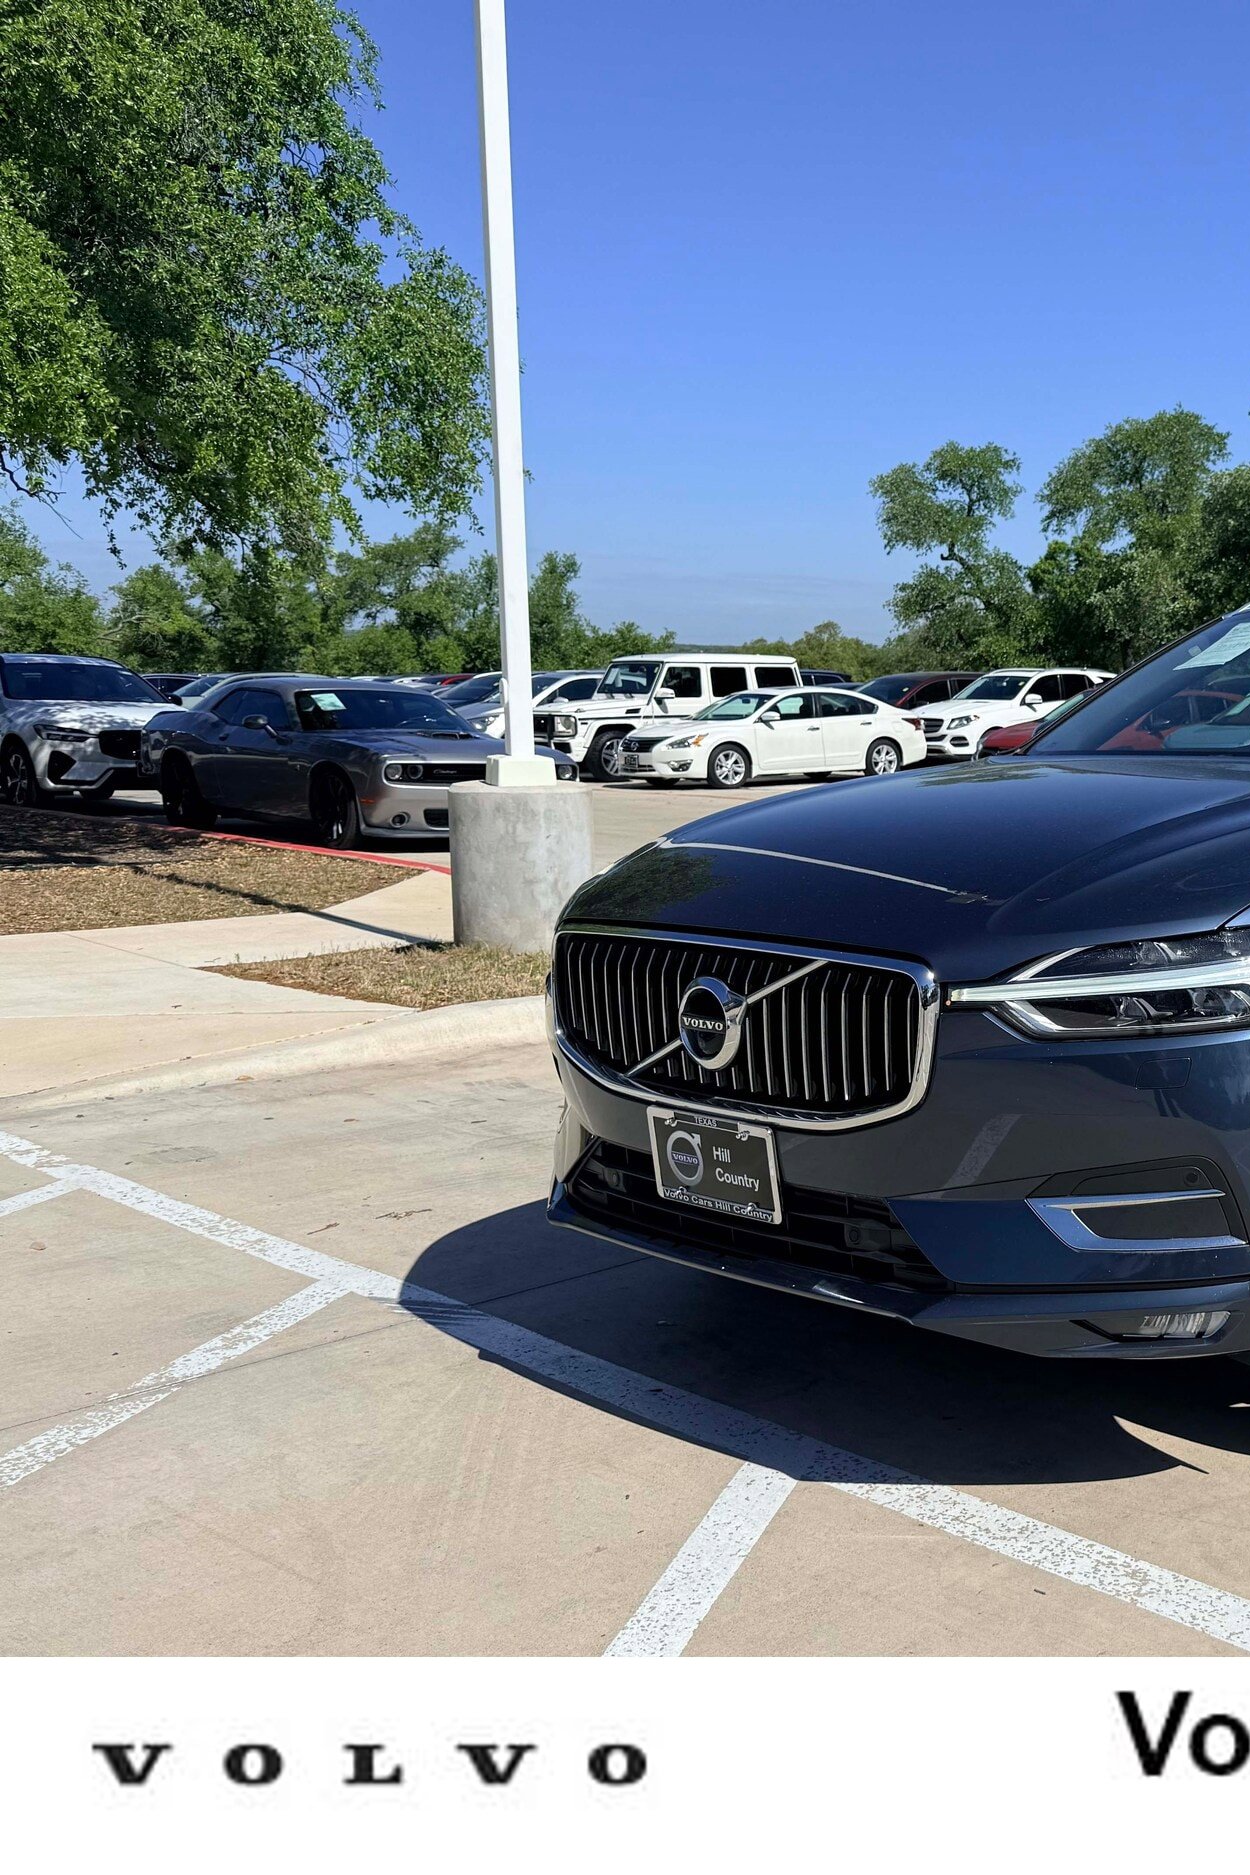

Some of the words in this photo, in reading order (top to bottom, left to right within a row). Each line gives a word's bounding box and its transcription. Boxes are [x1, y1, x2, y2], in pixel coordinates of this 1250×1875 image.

[682, 1016, 724, 1031] VOLVO
[694, 1116, 717, 1127] TEXAS
[672, 1153, 699, 1164] VOLVO
[713, 1146, 731, 1163] Hill
[715, 1168, 760, 1192] Country
[664, 1188, 689, 1202] Volvo
[691, 1195, 713, 1208] Cars
[715, 1201, 731, 1212] Hill
[733, 1205, 773, 1222] Country
